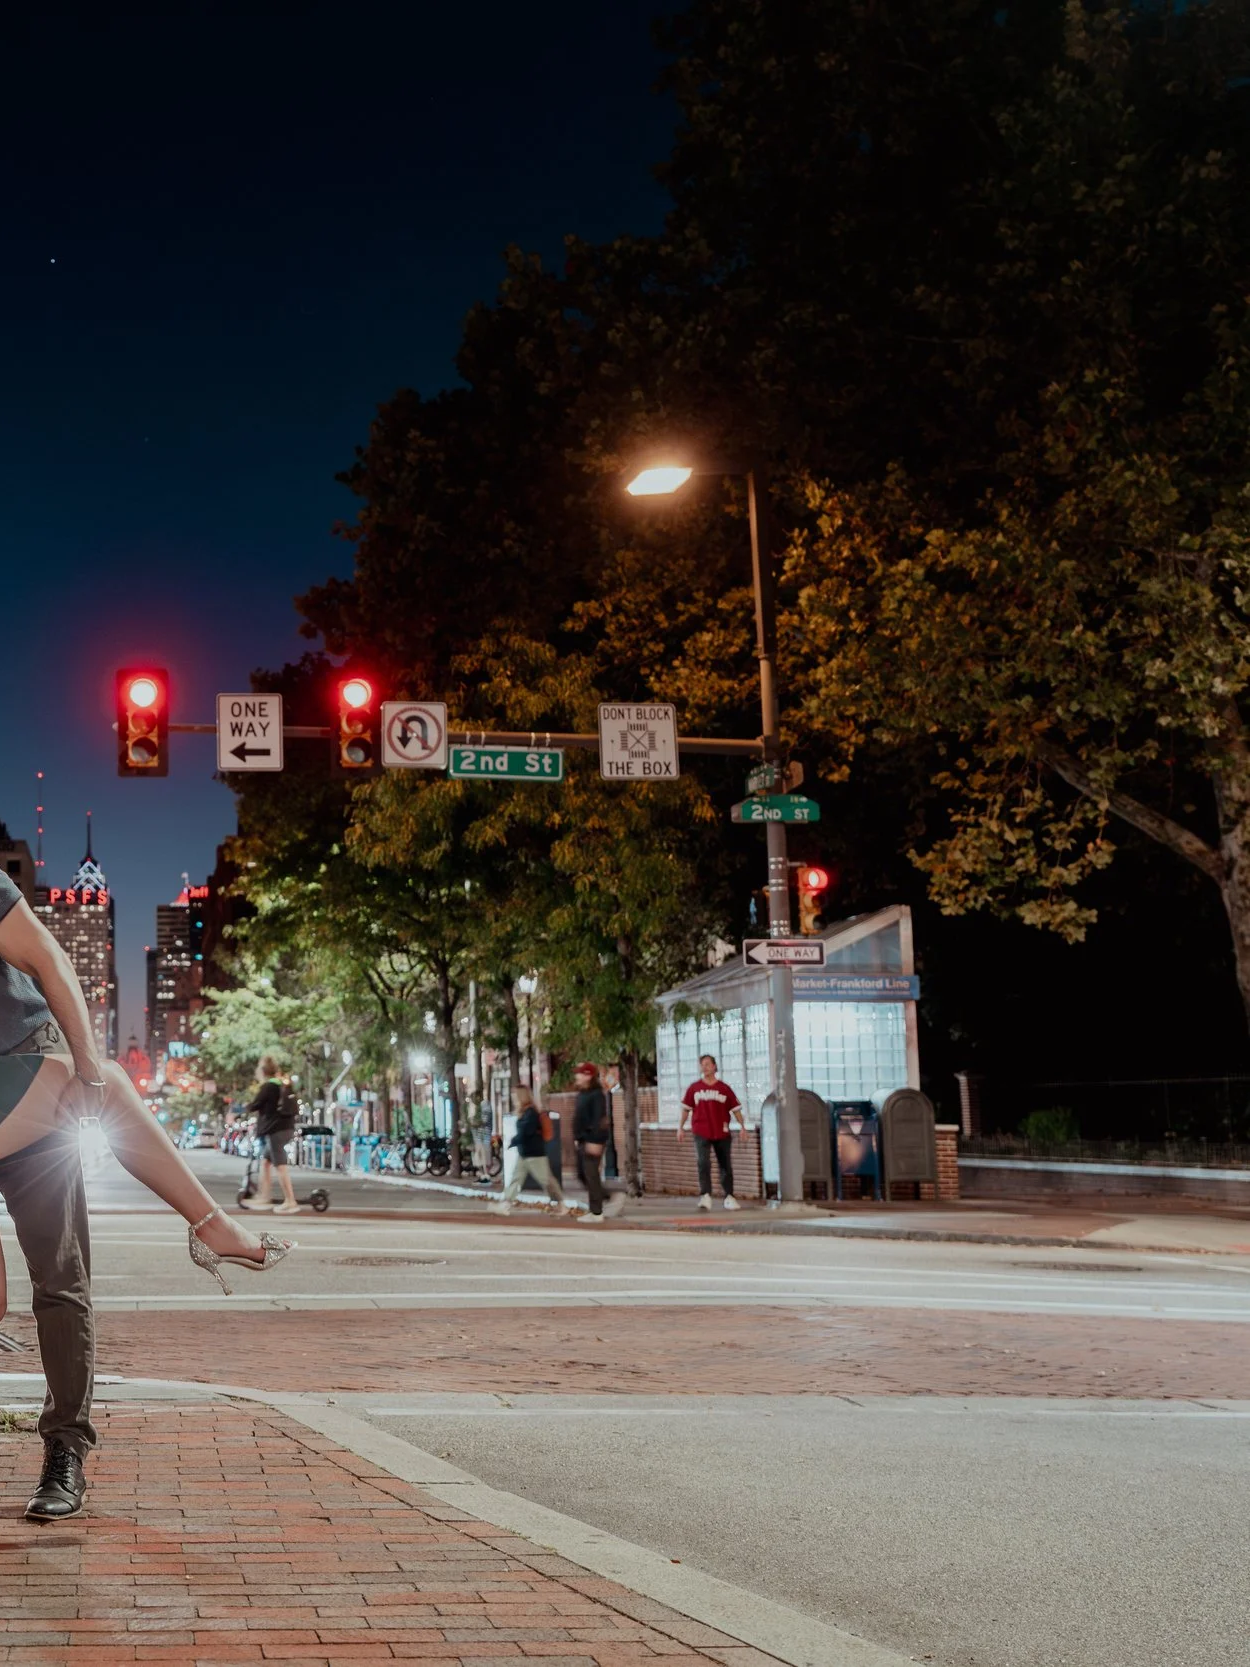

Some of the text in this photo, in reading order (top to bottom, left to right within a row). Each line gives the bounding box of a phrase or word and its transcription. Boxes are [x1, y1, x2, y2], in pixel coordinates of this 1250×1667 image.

[231, 702, 269, 718] ONE
[636, 707, 671, 720] BLOCK
[230, 721, 270, 737] WAY
[459, 751, 553, 773] 2nd St
[607, 761, 672, 775] THE BOX
[751, 804, 810, 820] 2ND ST
[50, 888, 108, 905] PSFS
[768, 946, 816, 958] ONE WAY
[885, 978, 911, 989] Line
